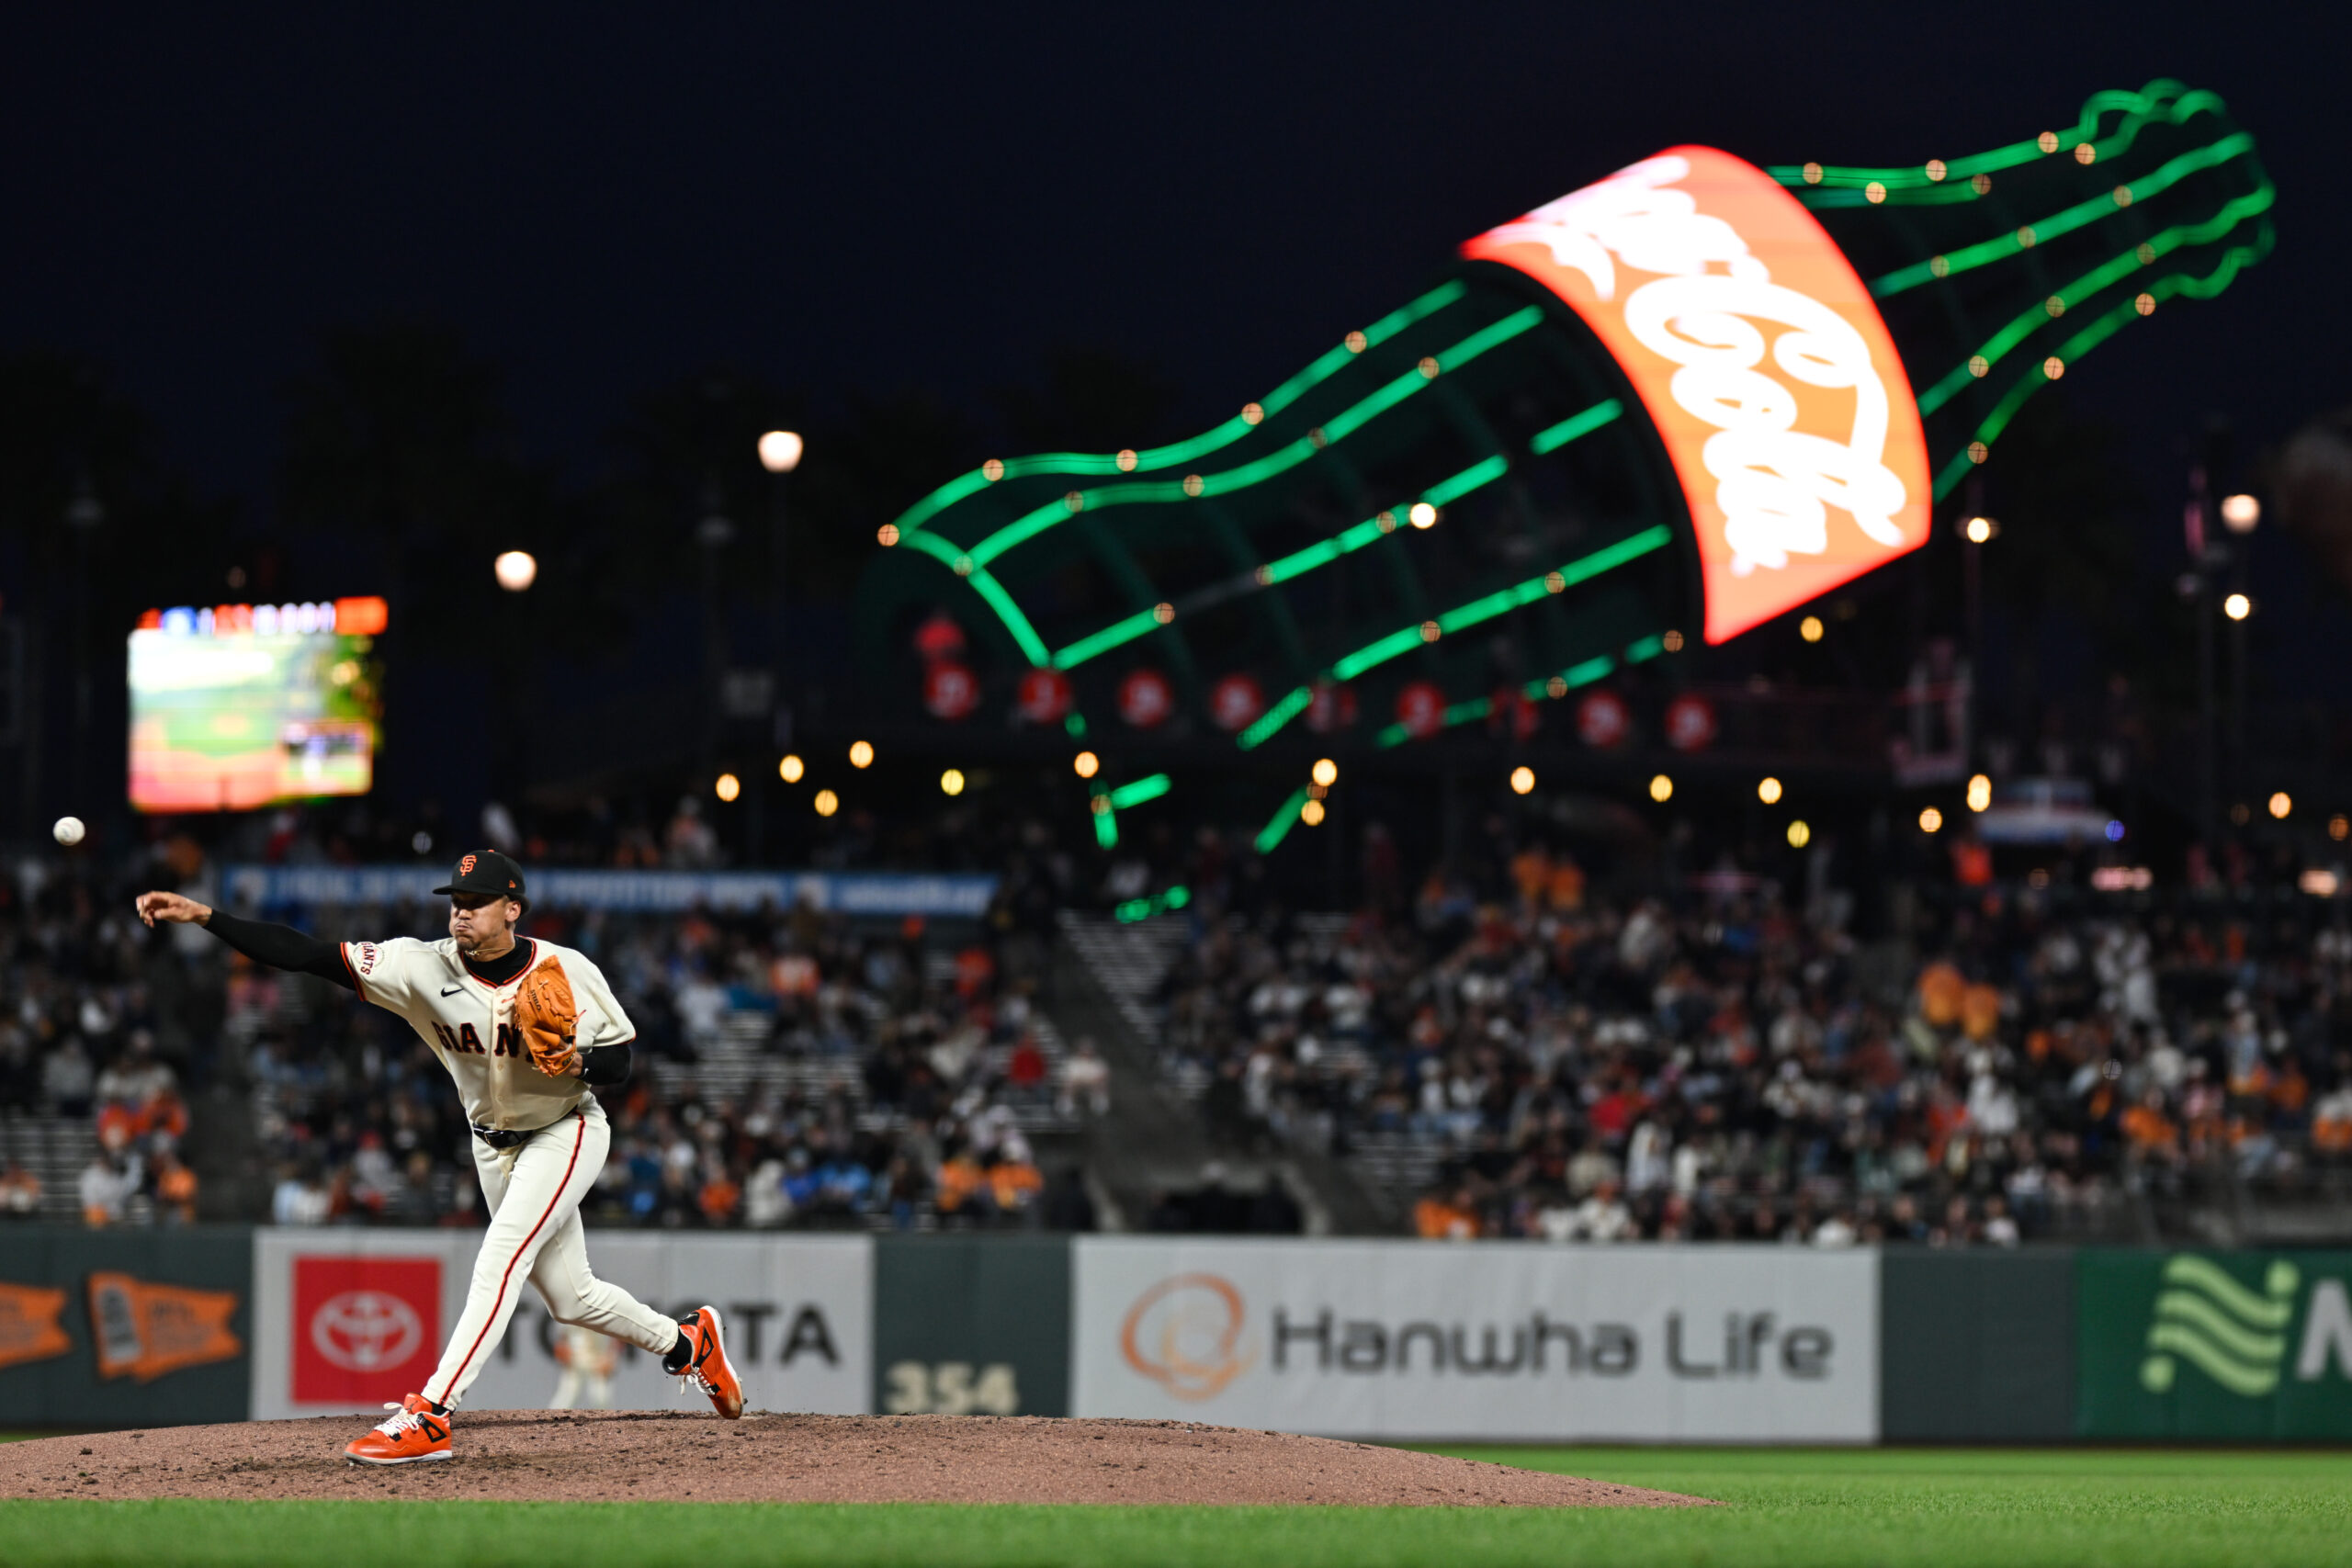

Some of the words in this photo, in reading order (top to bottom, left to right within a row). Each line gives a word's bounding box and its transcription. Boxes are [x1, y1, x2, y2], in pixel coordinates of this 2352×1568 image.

[431, 1021, 536, 1063] GIAN
[500, 1298, 840, 1370] TTA
[1272, 1306, 1641, 1377] Hanwha
[1665, 1309, 1833, 1380] Life
[886, 1359, 1019, 1415] 354
